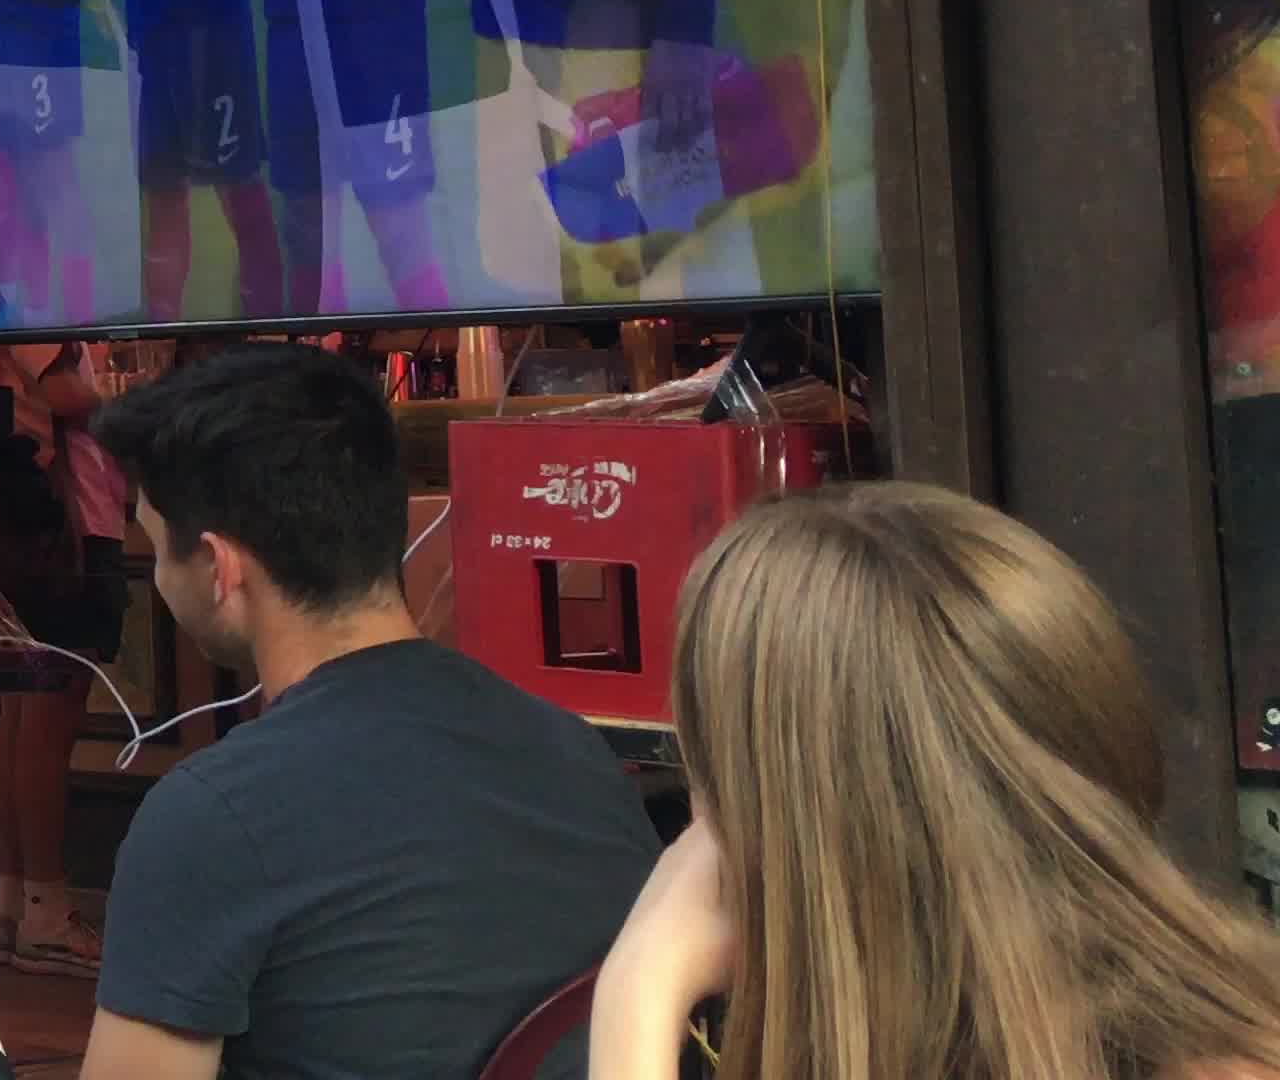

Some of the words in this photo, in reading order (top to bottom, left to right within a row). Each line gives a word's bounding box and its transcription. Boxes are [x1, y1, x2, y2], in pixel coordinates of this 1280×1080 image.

[31, 72, 52, 118] 3
[213, 94, 240, 147] 2
[384, 92, 414, 156] 4
